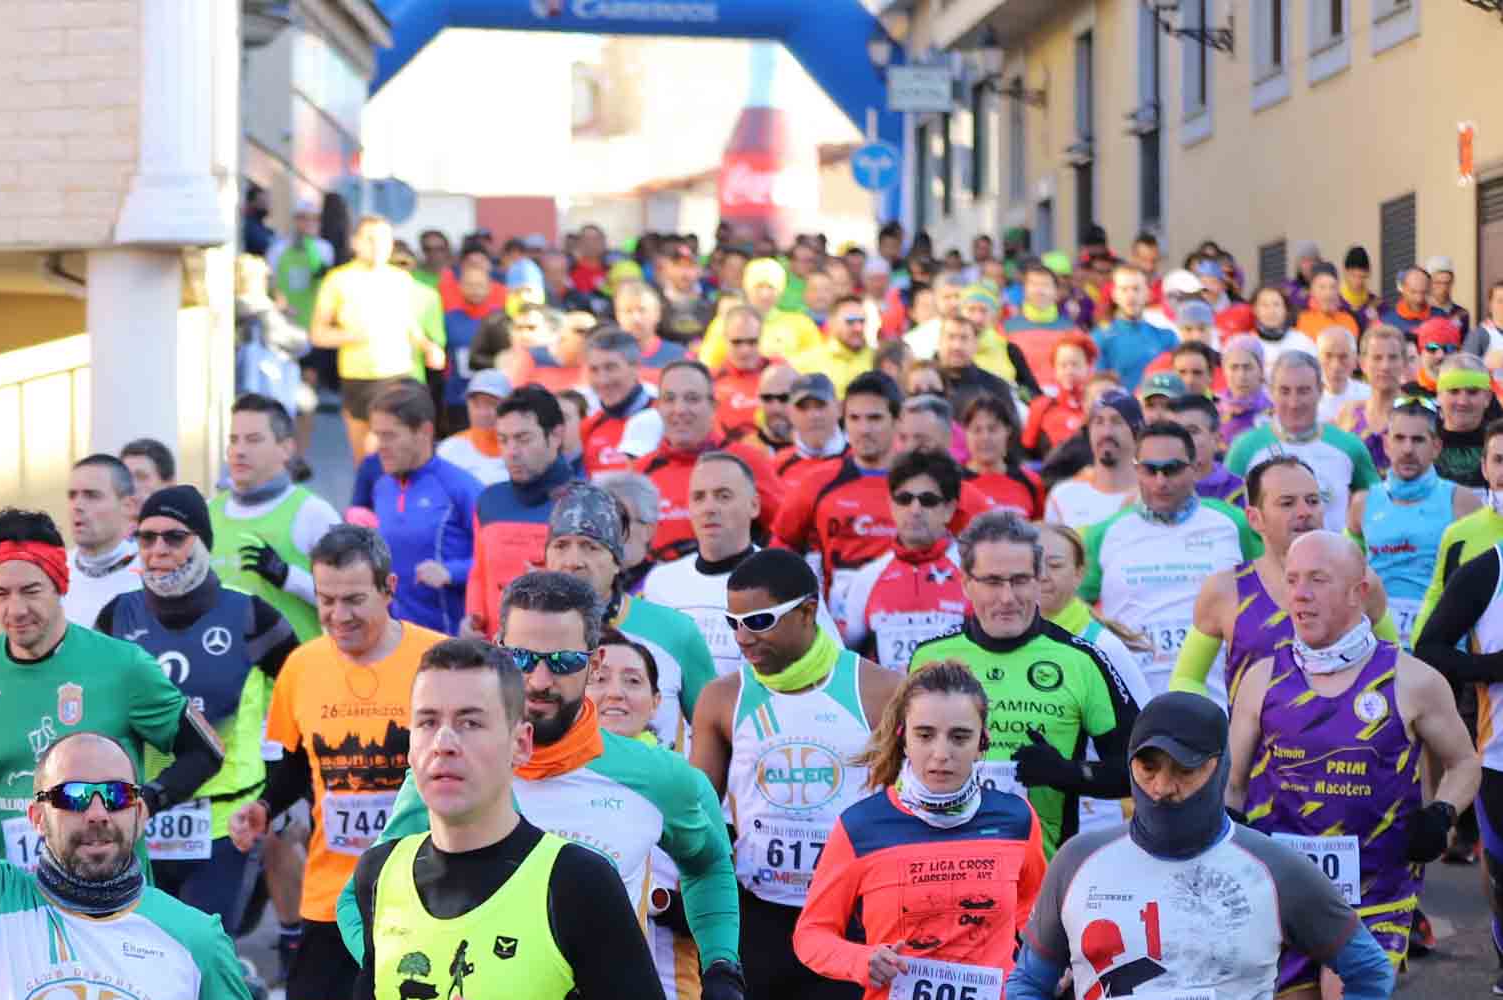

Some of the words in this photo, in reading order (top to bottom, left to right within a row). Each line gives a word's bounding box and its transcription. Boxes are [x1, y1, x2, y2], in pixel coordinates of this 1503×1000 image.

[910, 862, 924, 874] 27
[929, 860, 955, 872] LIGA
[959, 858, 995, 870] CROSS
